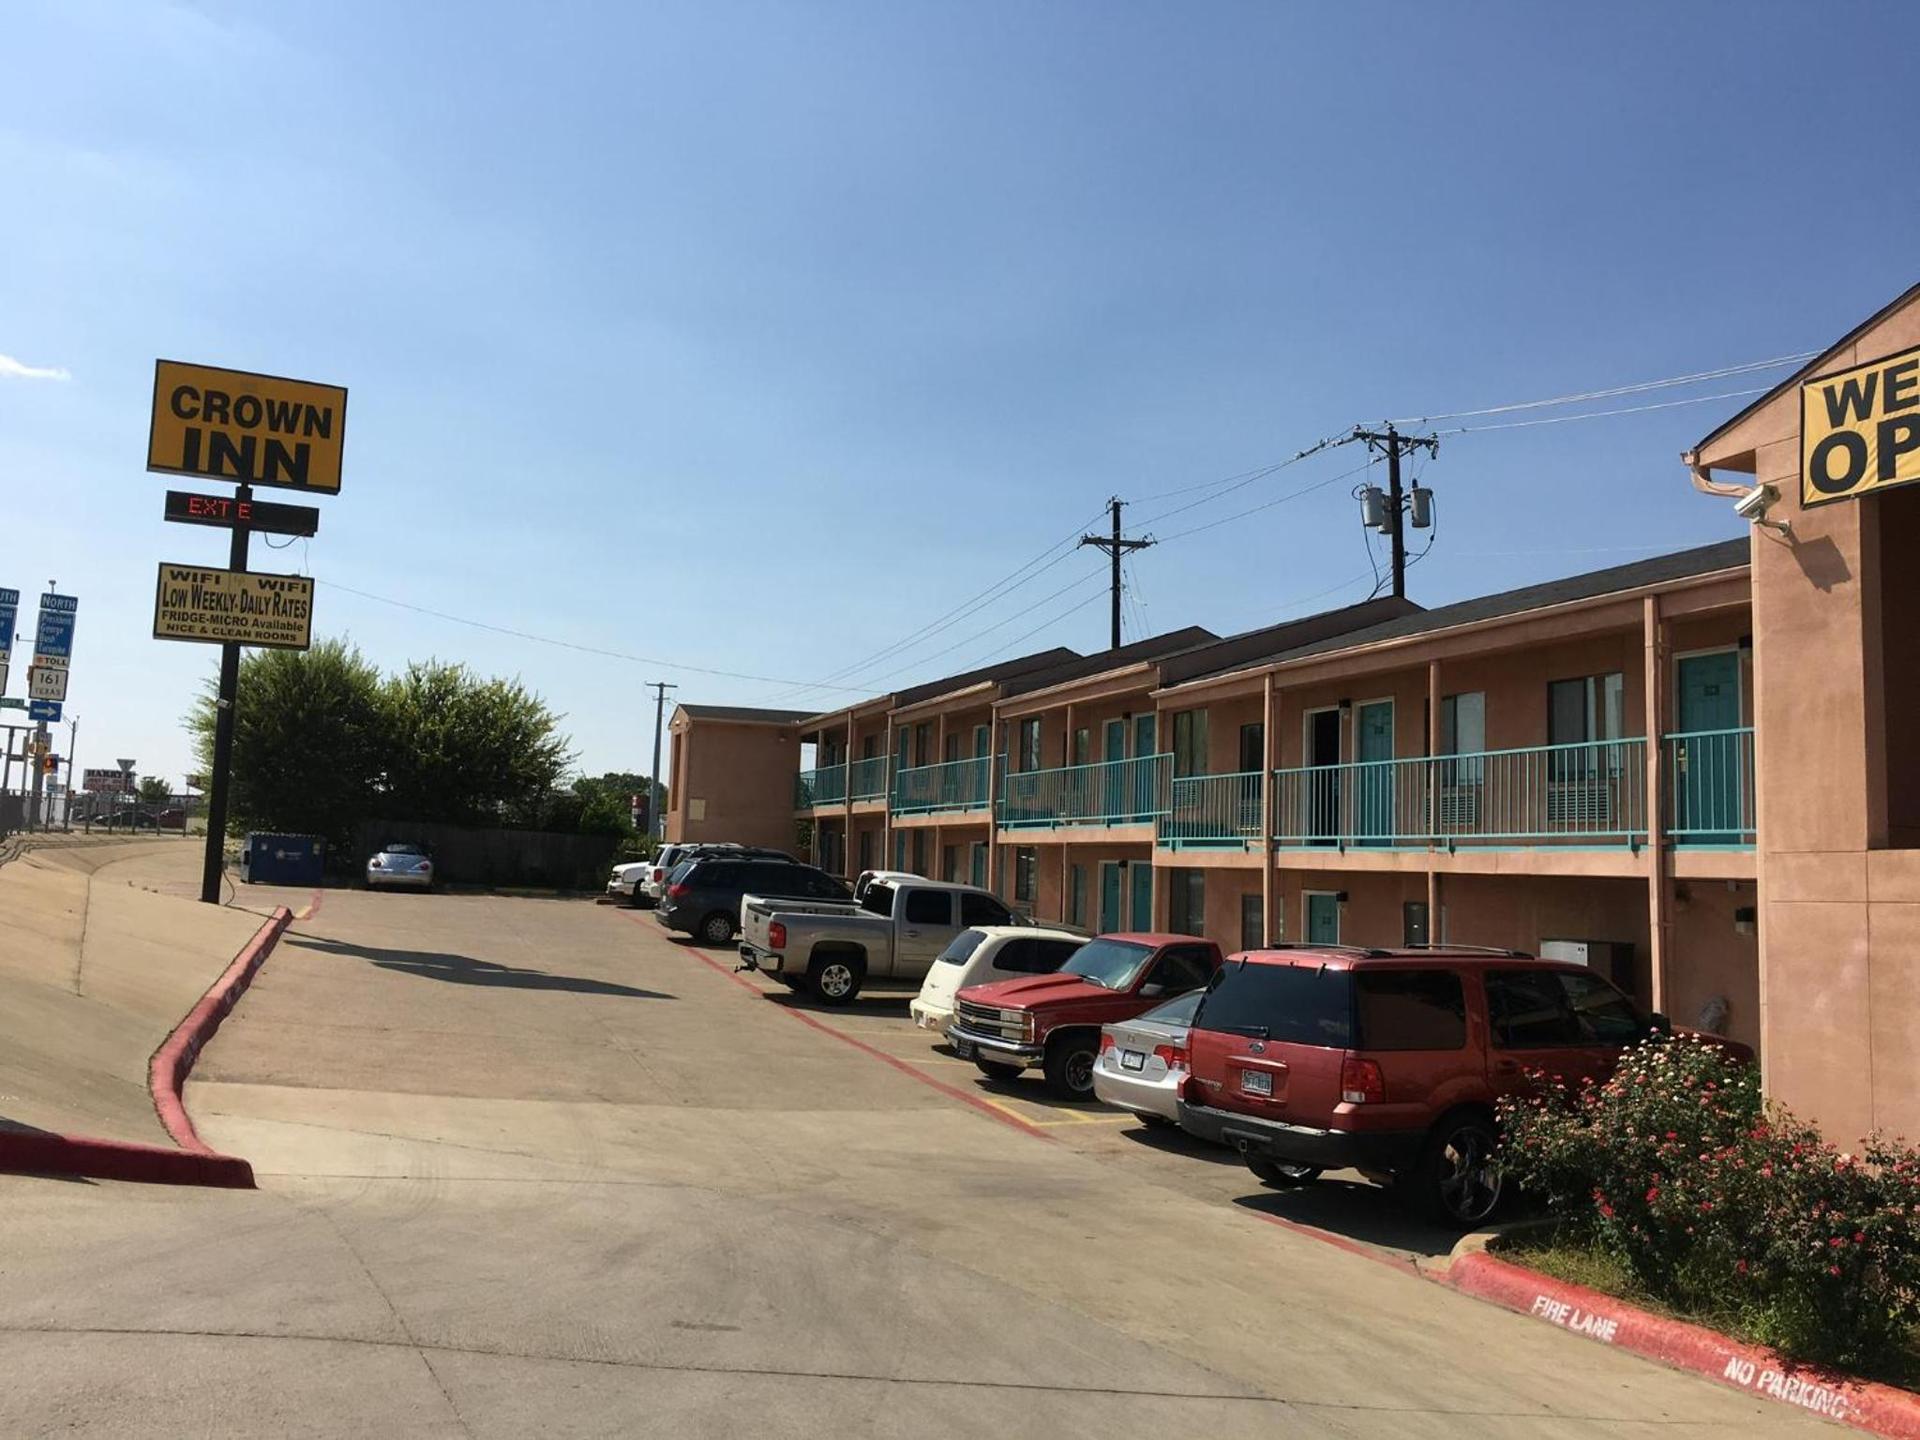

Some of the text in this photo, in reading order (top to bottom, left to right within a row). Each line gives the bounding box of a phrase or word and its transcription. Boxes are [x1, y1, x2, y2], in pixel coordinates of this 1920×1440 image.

[171, 385, 332, 439] CROWN
[182, 427, 311, 486] INN
[169, 569, 307, 594] WIFI WIFI
[42, 596, 76, 610] NORTH
[40, 623, 64, 636] George
[166, 623, 297, 642] NICE & CLEAN ROOMS
[252, 618, 304, 632] Available
[45, 656, 68, 667] TOLL
[40, 673, 60, 685] 161
[35, 687, 62, 696] TEXAS
[1530, 1295, 1618, 1342] FIRE LANE
[1723, 1356, 1850, 1420] NO PARKING
